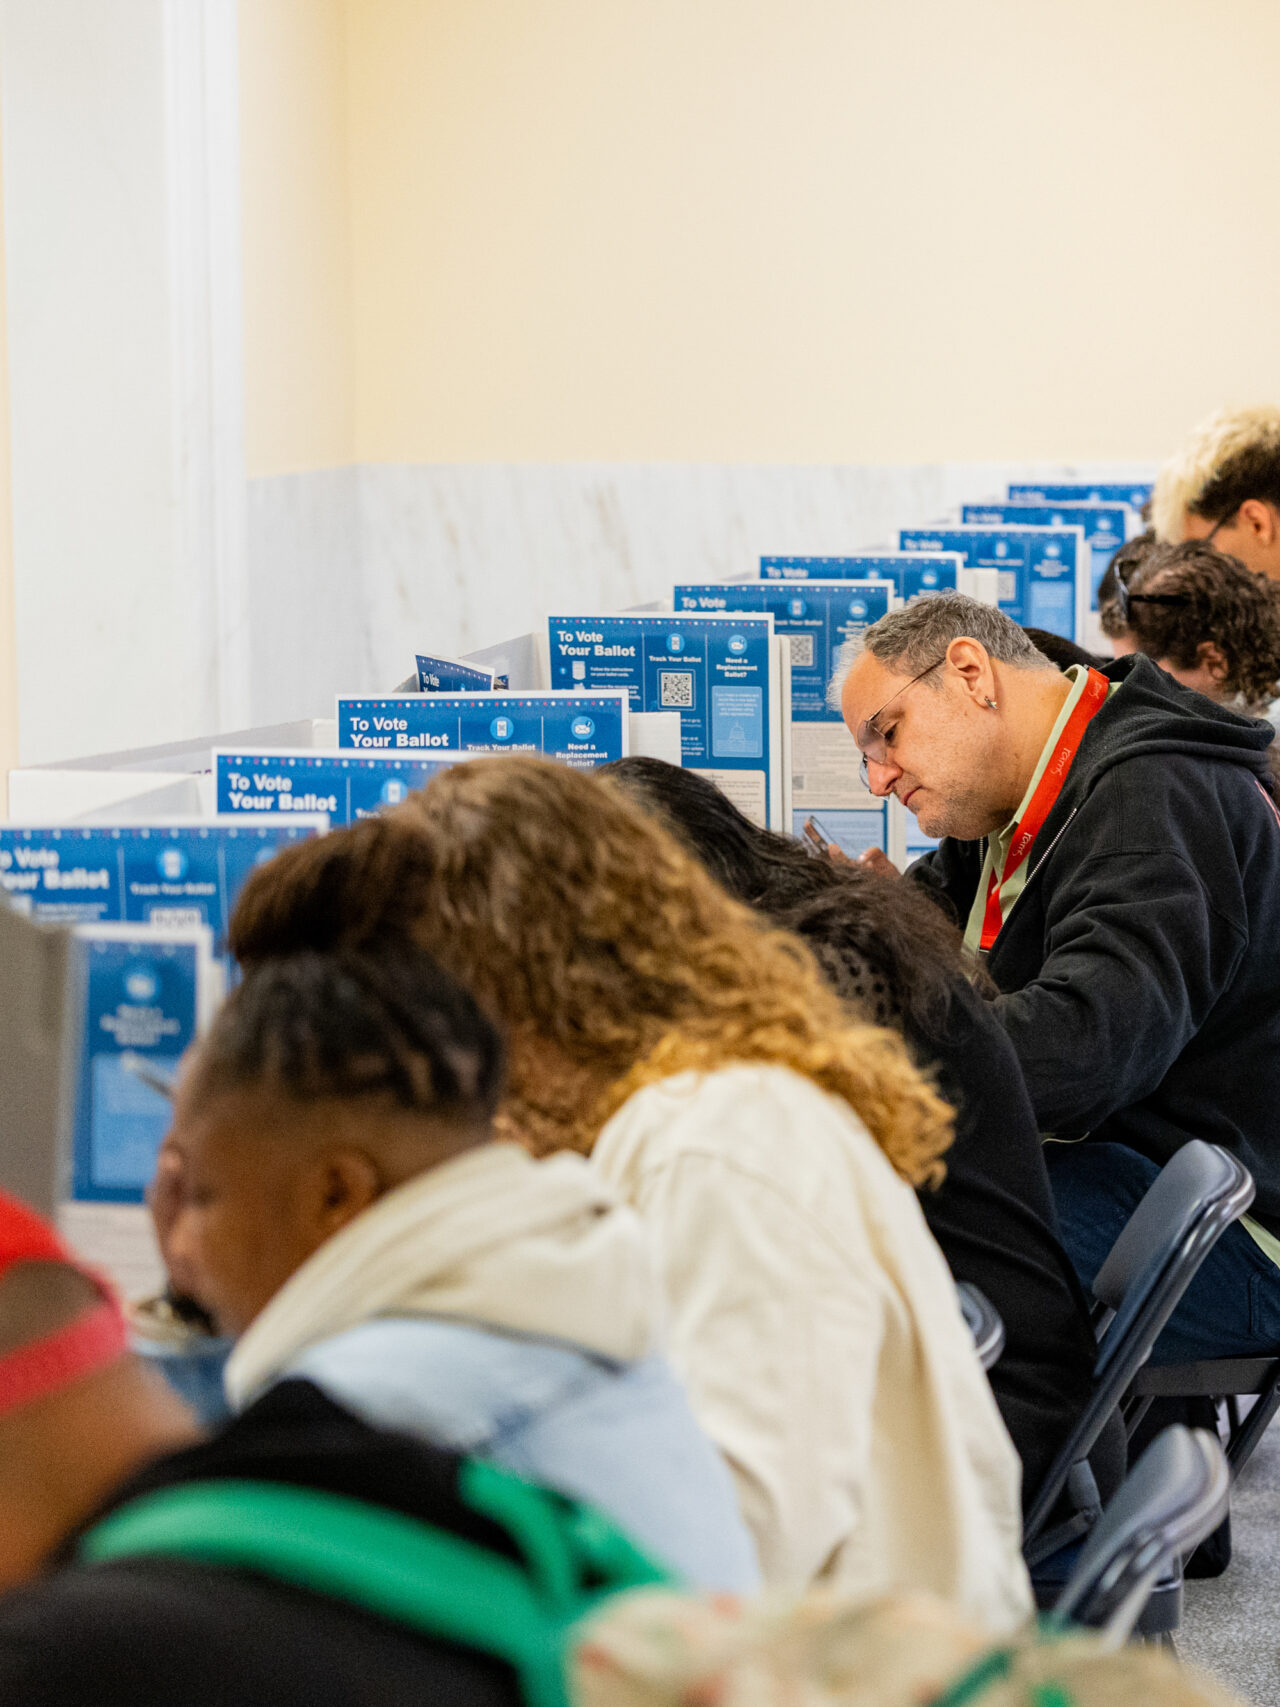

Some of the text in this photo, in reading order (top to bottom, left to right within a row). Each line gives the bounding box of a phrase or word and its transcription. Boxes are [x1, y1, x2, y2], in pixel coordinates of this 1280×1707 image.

[682, 597, 726, 609] To Vote
[557, 630, 603, 643] To Vote
[558, 644, 636, 657] Your Ballot
[422, 671, 440, 687] To Vote
[349, 716, 408, 731] To Vote
[350, 732, 449, 748] Your Ballot
[491, 743, 511, 751] Your
[511, 743, 536, 751] Ballot
[555, 751, 608, 759] Replacement
[566, 759, 596, 767] Ballot?
[227, 772, 293, 792] To Vote
[228, 791, 337, 812] Your Ballot
[0, 866, 110, 891] our Ballot
